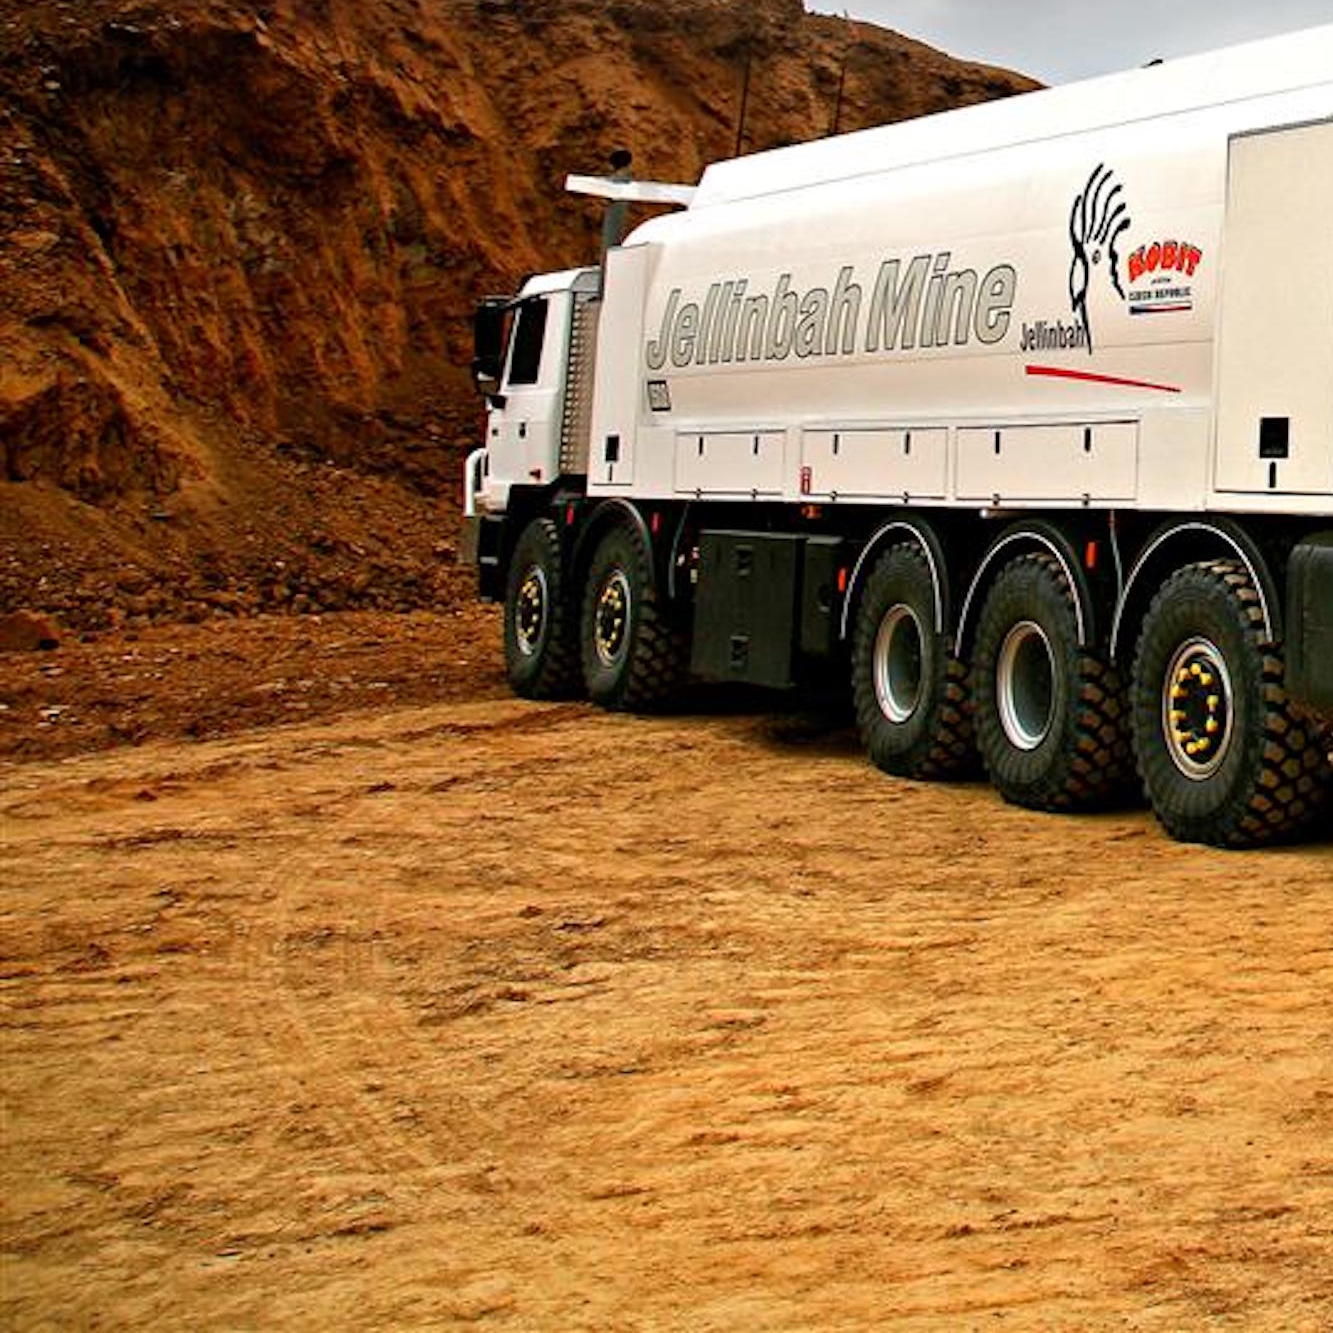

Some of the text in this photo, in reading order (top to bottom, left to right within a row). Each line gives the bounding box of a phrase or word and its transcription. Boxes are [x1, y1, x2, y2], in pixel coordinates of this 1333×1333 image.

[1128, 240, 1203, 284] KOBIT
[646, 251, 1017, 370] Jellinbah Mine
[1020, 319, 1086, 352] Jellinbah
